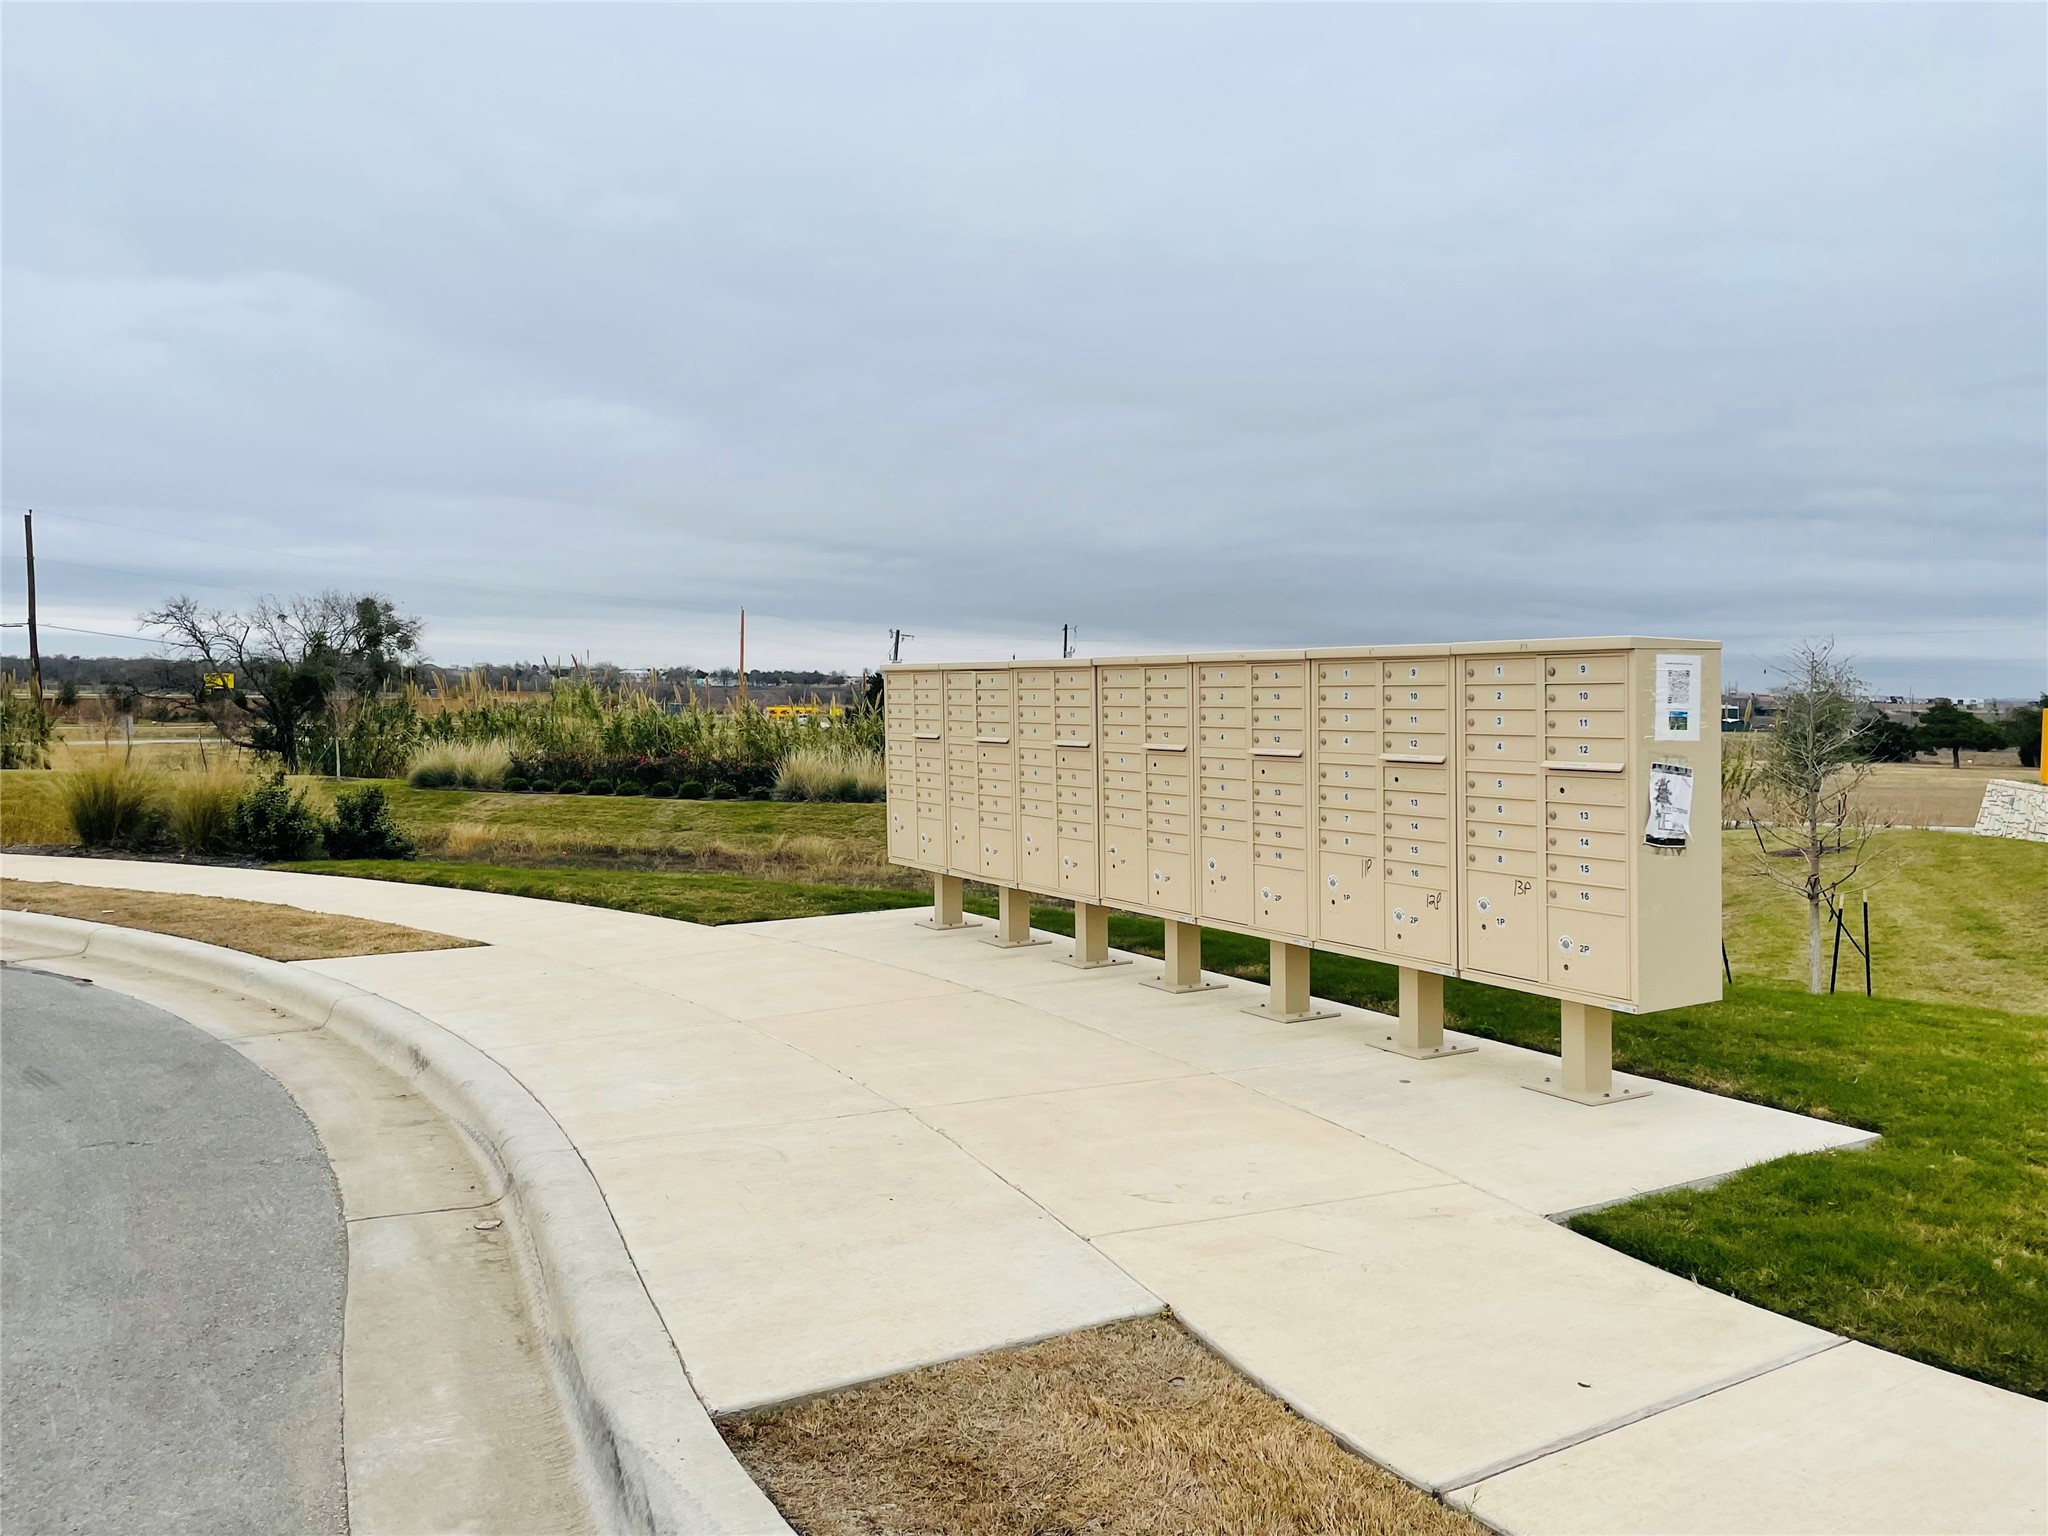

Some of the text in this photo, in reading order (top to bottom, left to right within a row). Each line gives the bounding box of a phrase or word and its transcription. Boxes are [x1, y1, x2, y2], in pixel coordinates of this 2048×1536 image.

[1344, 669, 1349, 677] 1
[1411, 668, 1416, 676] 9
[1496, 666, 1502, 675] 1
[1580, 665, 1586, 673] 9
[1344, 692, 1349, 700] 2
[1410, 692, 1418, 700] 10
[1496, 691, 1502, 700] 2
[1579, 692, 1588, 700] 10
[1344, 714, 1349, 722] 3
[1409, 716, 1418, 724] 11
[1497, 717, 1502, 725] 3
[1579, 718, 1588, 727] 11
[1344, 737, 1349, 745] 4
[1410, 739, 1418, 747] 12
[1497, 742, 1502, 751] 4
[1579, 745, 1588, 754] 12
[1344, 770, 1349, 778] 5
[1498, 780, 1503, 788] 5
[1344, 793, 1349, 801] 6
[1410, 799, 1418, 807] 13
[1498, 805, 1503, 814] 6
[1344, 815, 1349, 823] 7
[1580, 811, 1589, 820] 13
[1410, 822, 1419, 830] 14
[1498, 829, 1503, 838] 7
[1344, 838, 1349, 846] 8
[1580, 838, 1589, 846] 14
[1410, 846, 1419, 854] 15
[1498, 855, 1503, 864] 8
[1580, 864, 1590, 873] 15
[1411, 870, 1419, 878] 16
[1342, 893, 1351, 901] 1P
[1580, 892, 1590, 900] 16
[1410, 916, 1420, 924] 2P
[1496, 917, 1506, 926] 1P
[1580, 944, 1591, 953] 2P
